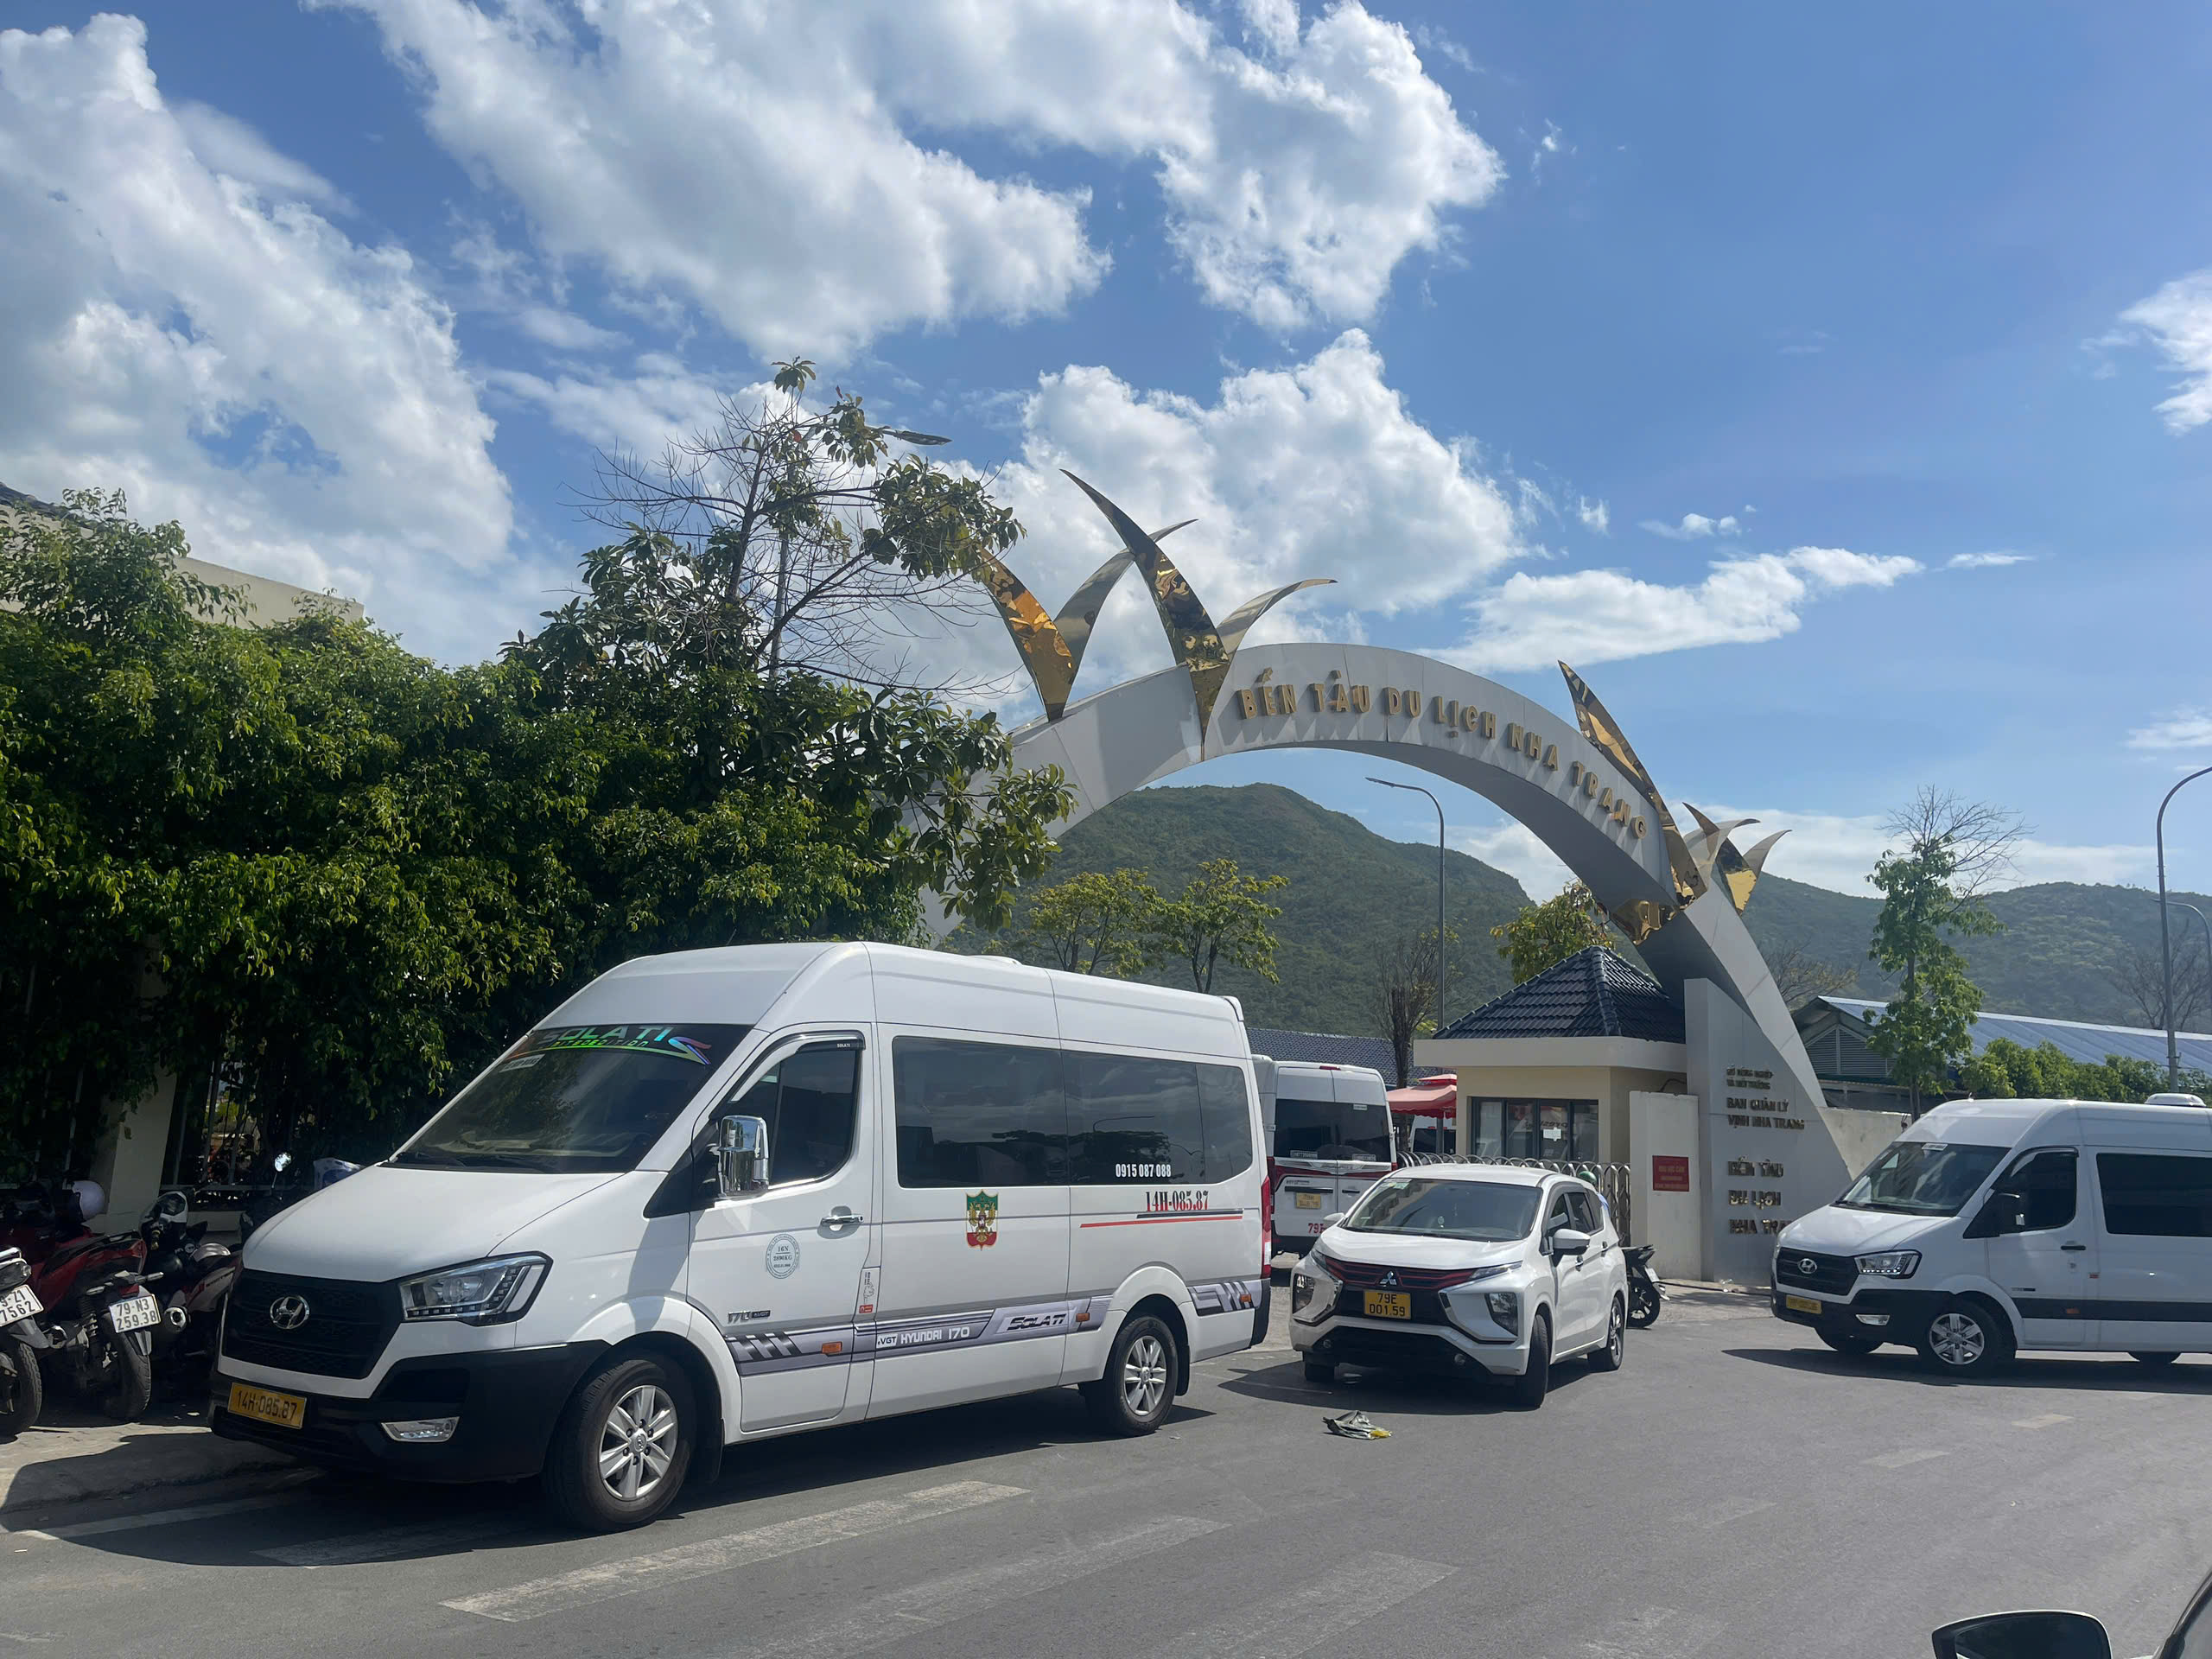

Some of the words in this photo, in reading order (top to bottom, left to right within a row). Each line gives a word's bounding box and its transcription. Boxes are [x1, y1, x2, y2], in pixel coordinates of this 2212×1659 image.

[1382, 686, 1421, 719] DU
[1433, 696, 1497, 740] LỊCH
[1507, 722, 1559, 772] NHA
[1573, 760, 1648, 840] TRANG
[1116, 1163, 1137, 1178] 0915
[1139, 1164, 1154, 1178] 087
[1155, 1164, 1172, 1178] 088
[1146, 1190, 1209, 1211] 14H-085.87
[117, 1299, 149, 1316] 79-N3
[1377, 1293, 1397, 1304] 79E
[1370, 1303, 1405, 1317] 001.59
[117, 1311, 157, 1331] 259.38
[1007, 1313, 1066, 1331] SOLATI
[900, 1330, 942, 1344] HYUNDAI
[949, 1326, 969, 1339] 170
[238, 1390, 297, 1422] 14H-085.87
